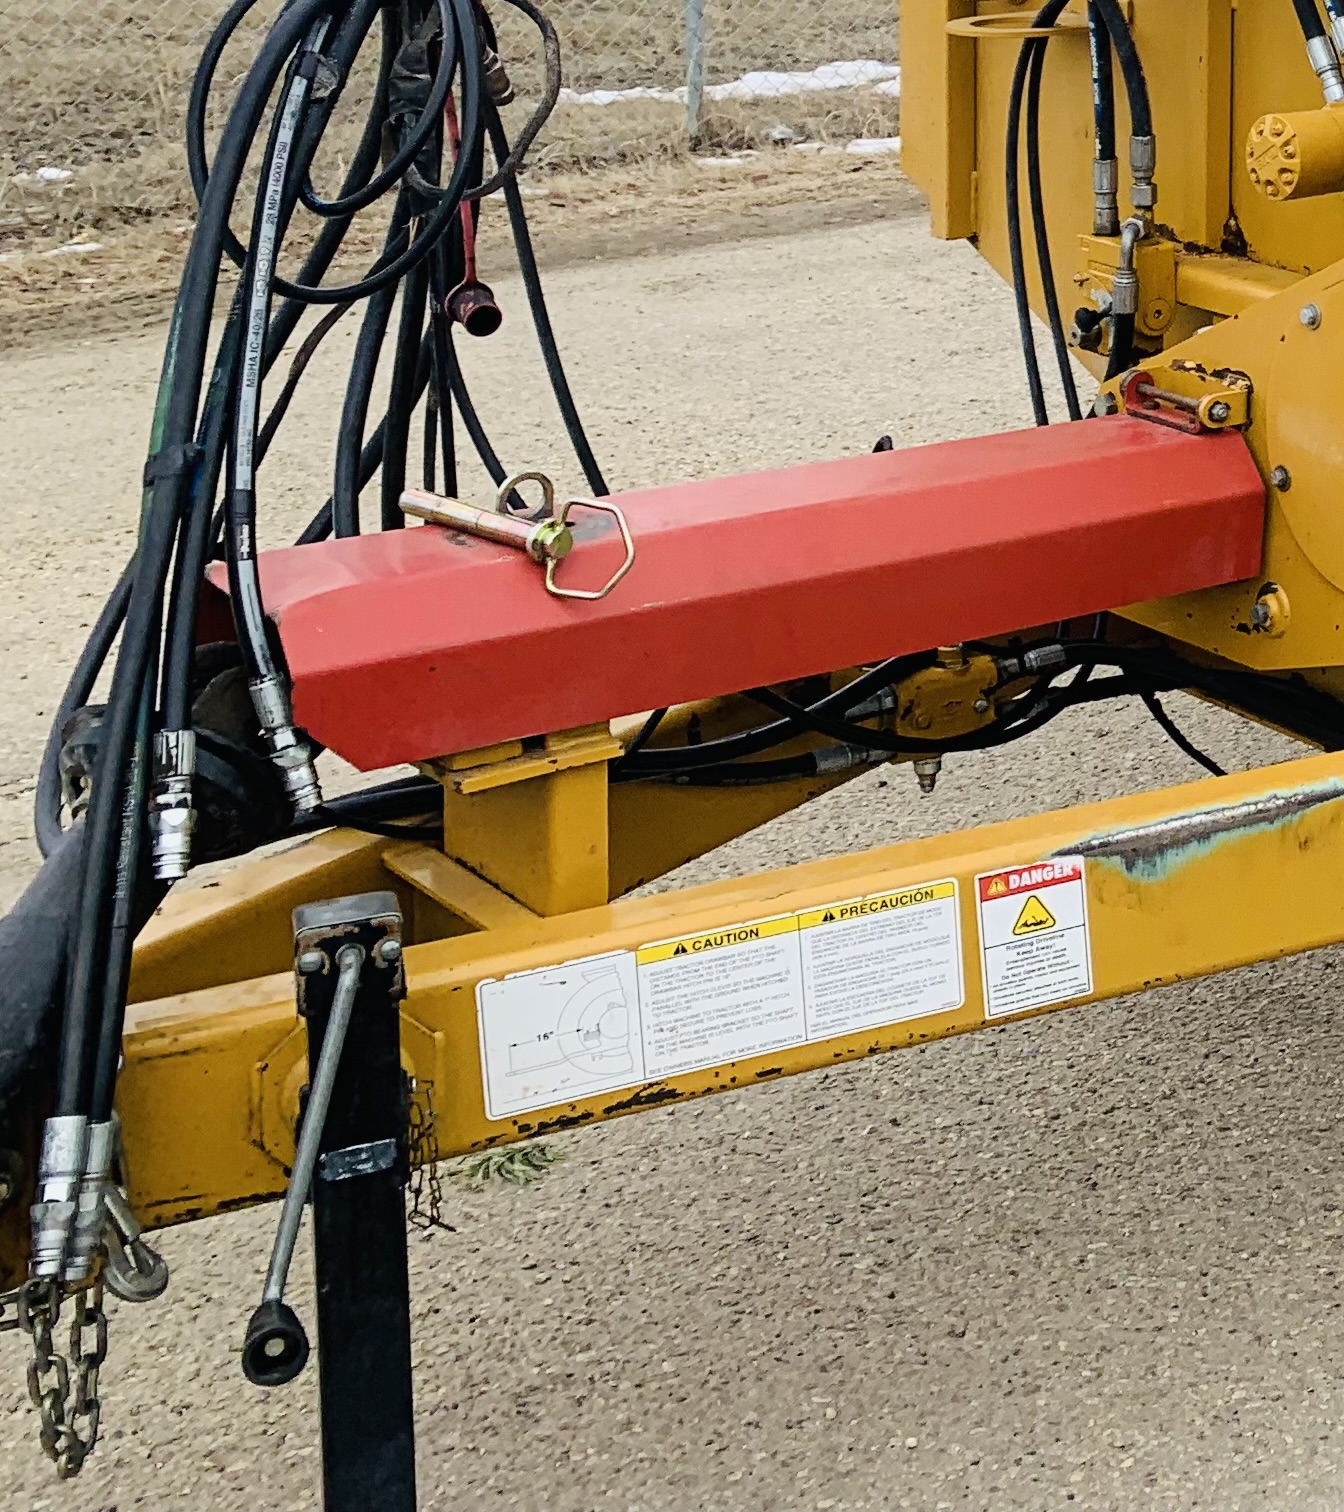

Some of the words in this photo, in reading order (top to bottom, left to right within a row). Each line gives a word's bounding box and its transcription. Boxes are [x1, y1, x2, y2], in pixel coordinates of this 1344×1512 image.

[245, 356, 259, 388] MSHA
[1008, 861, 1074, 890] DANGER
[840, 888, 935, 919] PRECAUCIÓN
[692, 927, 760, 952] CAUTION
